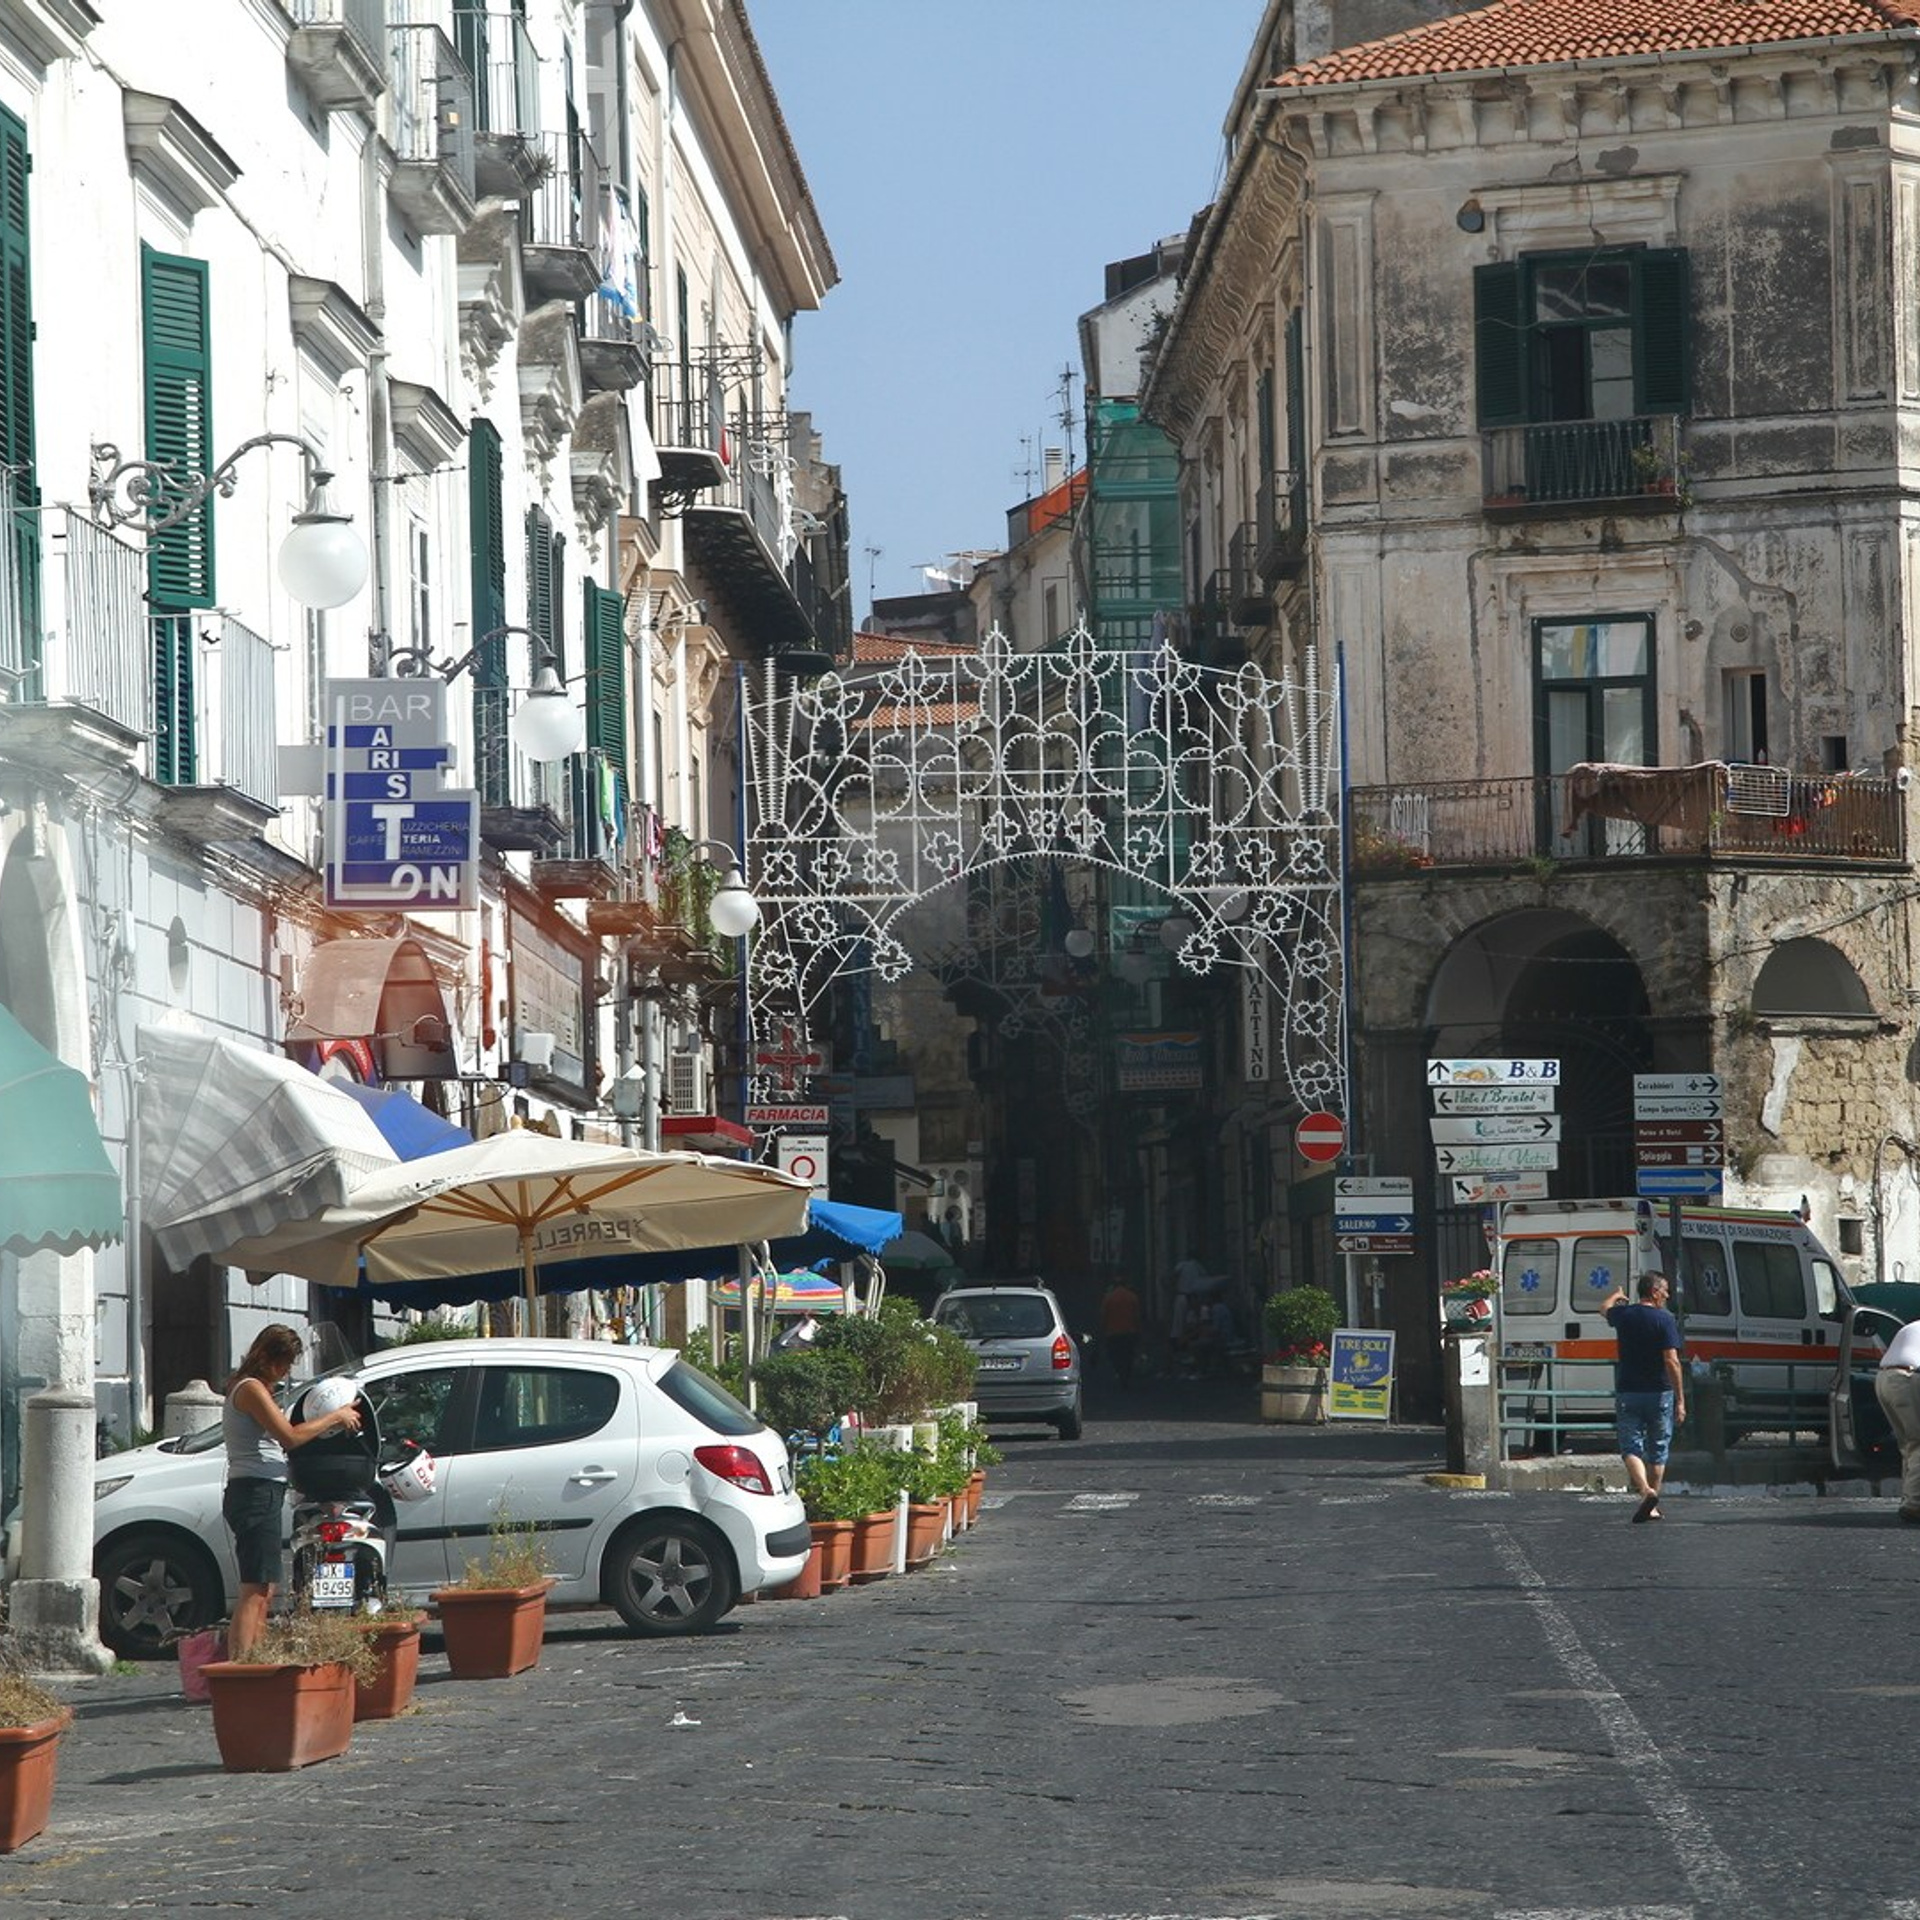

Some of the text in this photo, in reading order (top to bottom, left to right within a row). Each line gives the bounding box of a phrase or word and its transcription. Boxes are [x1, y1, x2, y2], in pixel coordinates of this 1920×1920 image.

[351, 694, 432, 721] BAR
[1245, 969, 1264, 1079] MATTINO
[1637, 1081, 1674, 1090] Carabinieri
[1454, 1090, 1488, 1103] Hotel
[747, 1109, 826, 1121] FARMACIA
[1639, 1150, 1673, 1162] Spiaggia
[1338, 1219, 1378, 1230] SALERNO
[315, 1580, 352, 1596] 19495
